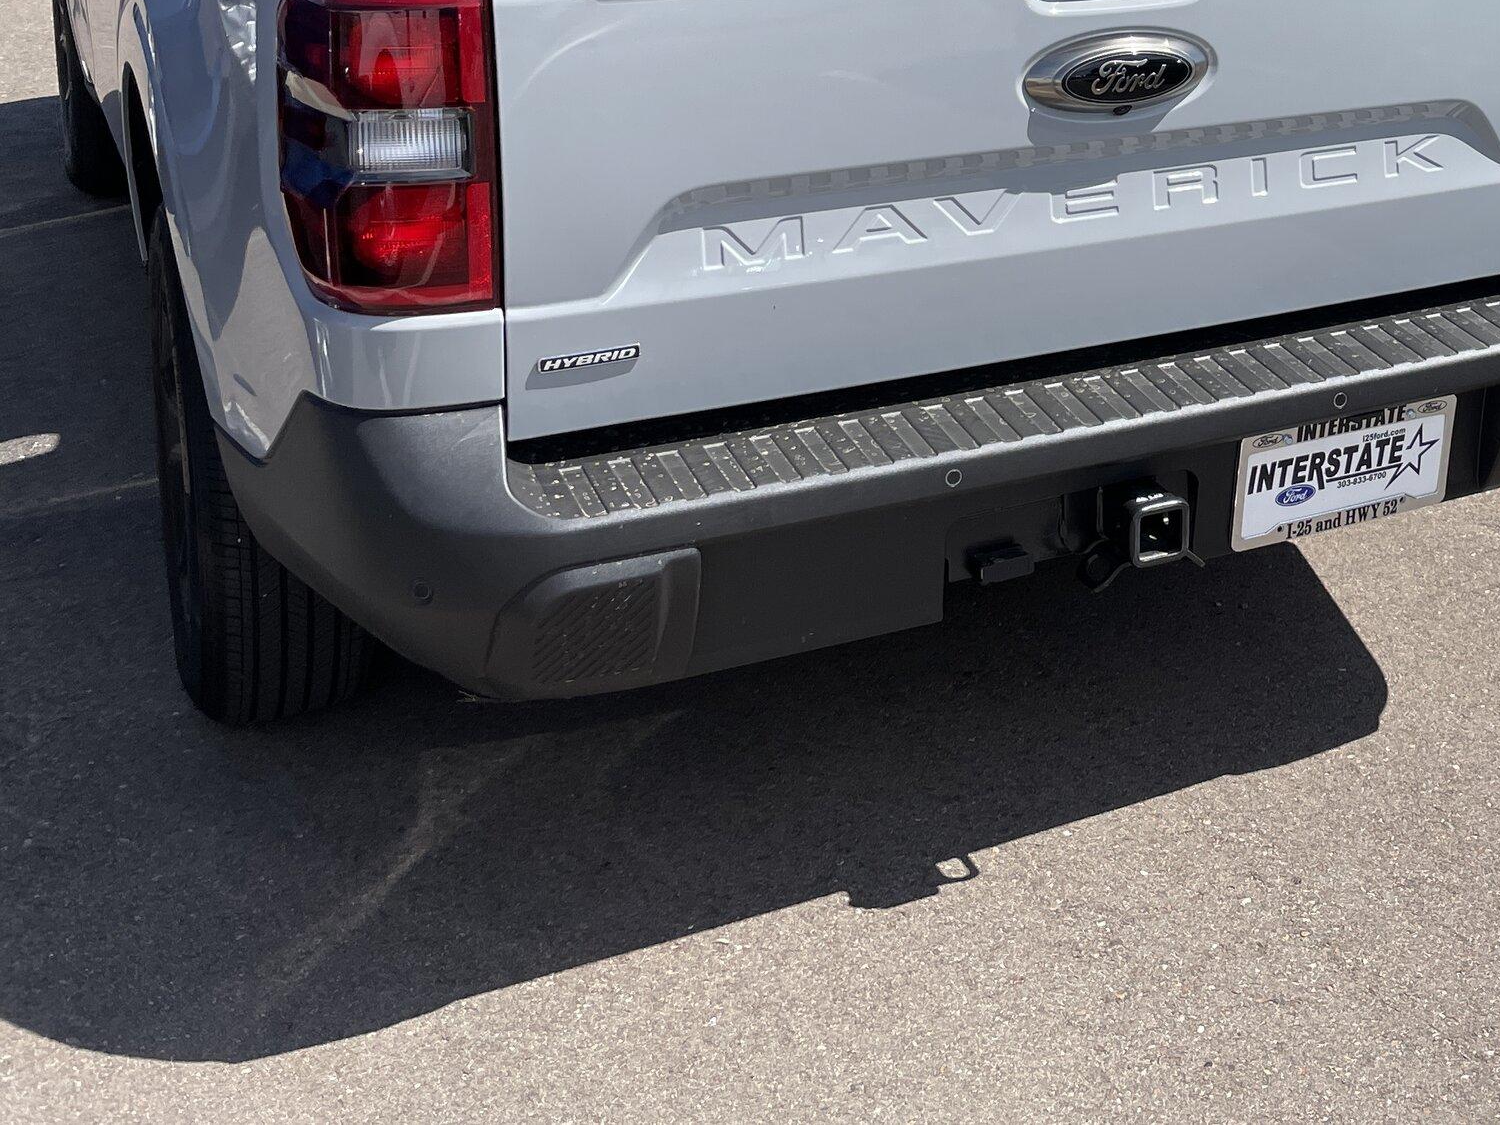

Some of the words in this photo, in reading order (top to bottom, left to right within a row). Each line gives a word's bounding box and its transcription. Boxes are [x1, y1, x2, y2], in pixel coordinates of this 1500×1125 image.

[1091, 58, 1167, 96] Ford
[700, 134, 1443, 271] MAVERICK
[543, 347, 637, 371] HYBRID
[1425, 401, 1444, 413] Ford
[1256, 434, 1280, 447] Ford
[1247, 434, 1405, 495] INTERSTATE
[1336, 471, 1386, 489] 303-833-6700
[1282, 487, 1309, 504] Ford
[1285, 518, 1312, 540] I-25
[1315, 514, 1342, 534] and
[1344, 503, 1380, 527] HWY
[1382, 499, 1399, 517] 52
